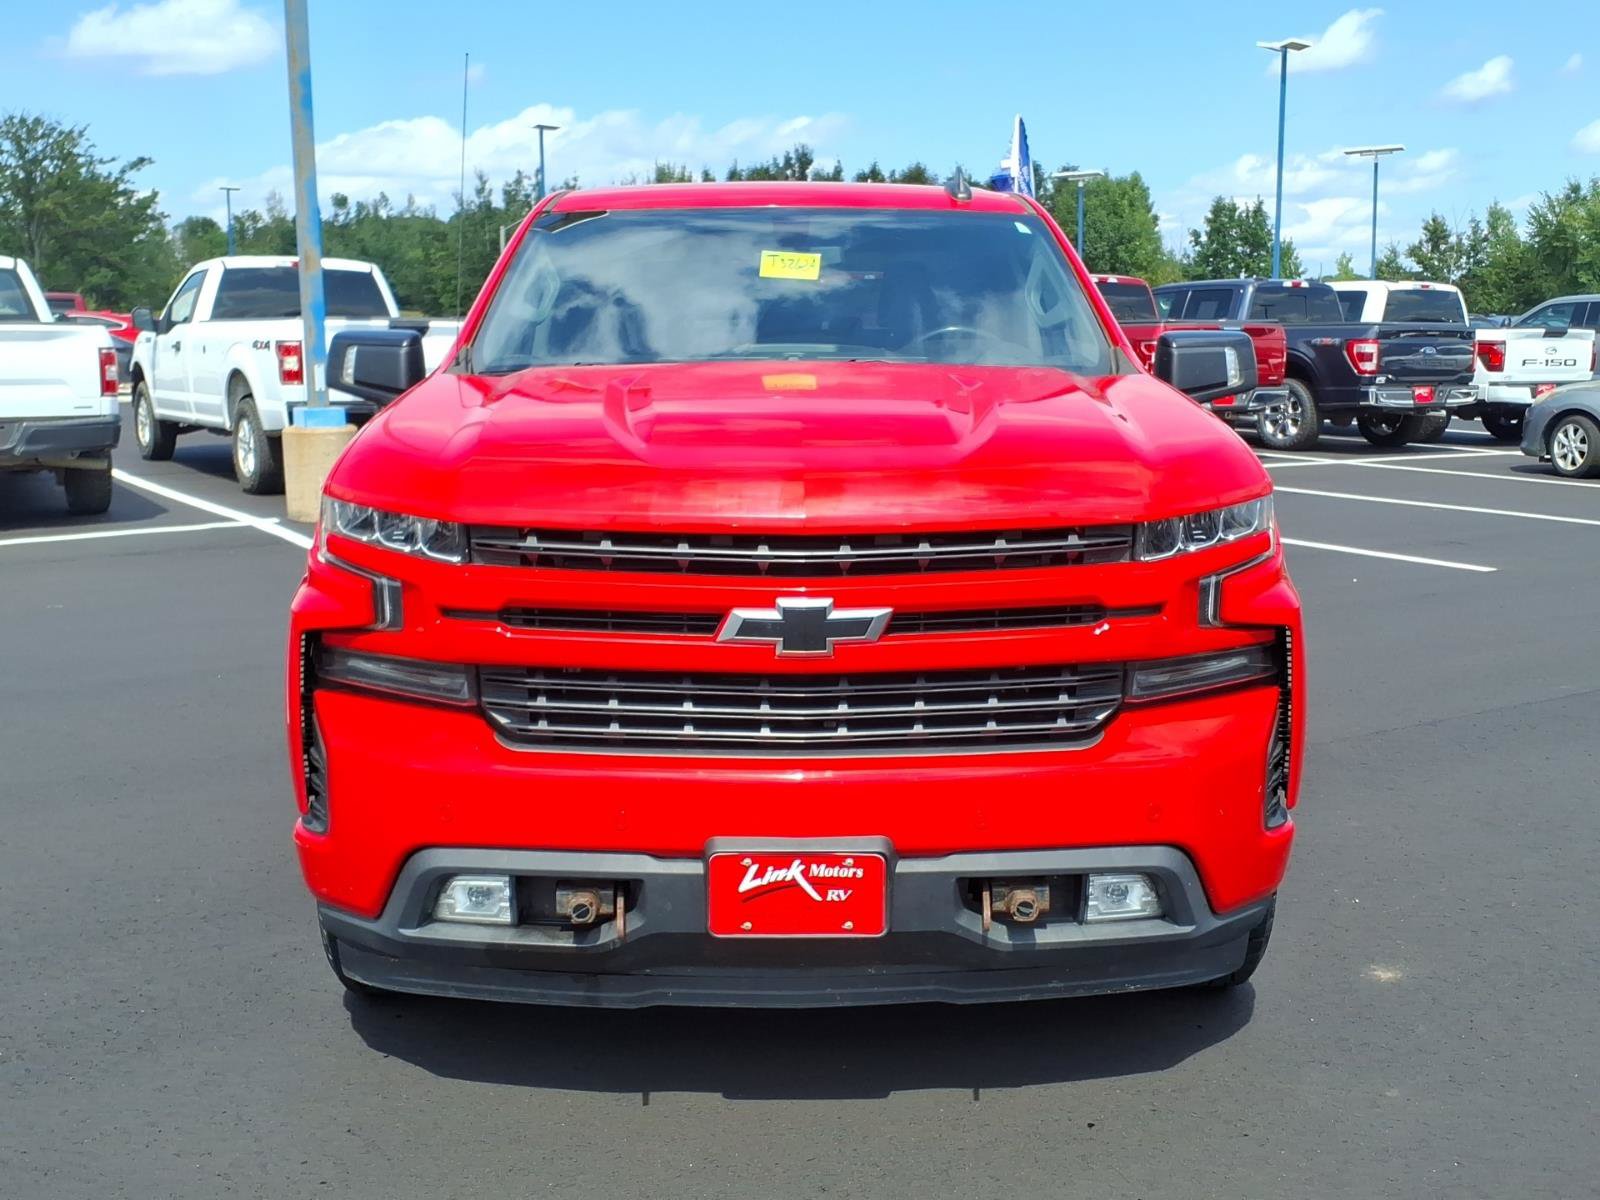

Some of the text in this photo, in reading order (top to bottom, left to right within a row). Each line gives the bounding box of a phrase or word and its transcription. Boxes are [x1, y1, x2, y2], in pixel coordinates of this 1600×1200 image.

[1521, 358, 1577, 367] F-150
[739, 859, 864, 901] Link Motors
[825, 889, 853, 902] RV
